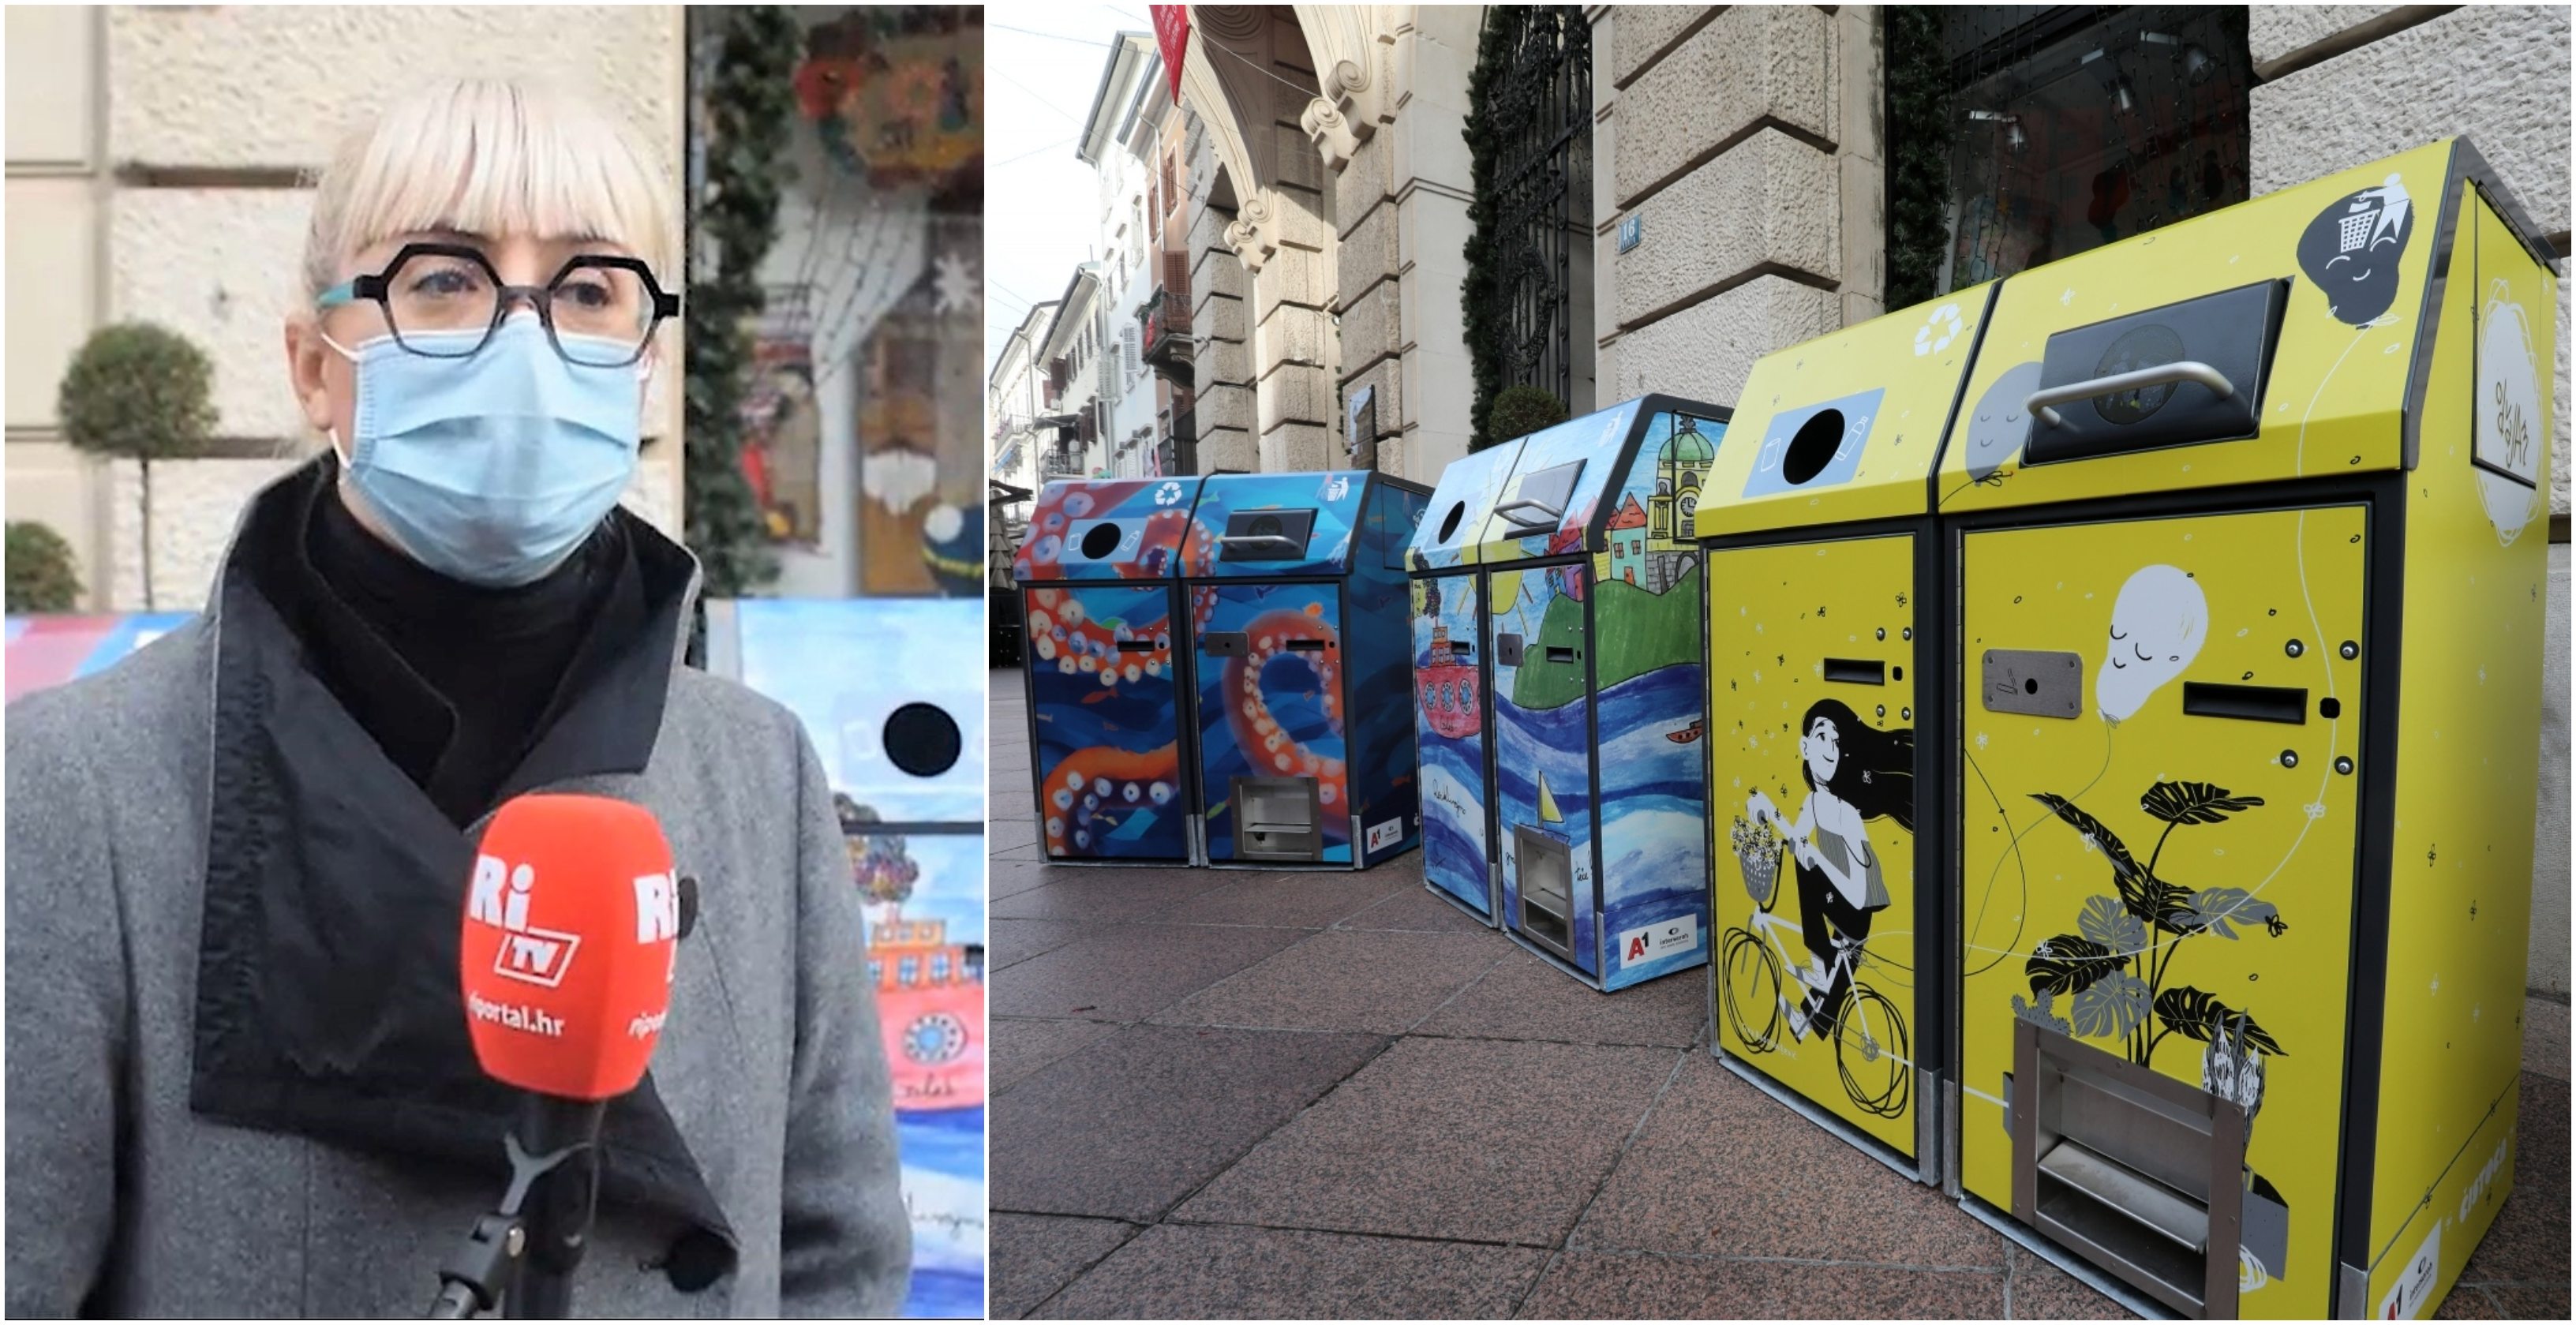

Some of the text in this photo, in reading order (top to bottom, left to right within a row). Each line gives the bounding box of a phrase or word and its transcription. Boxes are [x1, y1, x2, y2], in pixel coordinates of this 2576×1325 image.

[1623, 219, 1635, 241] 16
[1371, 829, 1380, 848] A1
[469, 853, 535, 932] Ri
[511, 938, 560, 975] TV
[1627, 931, 1649, 961] A1
